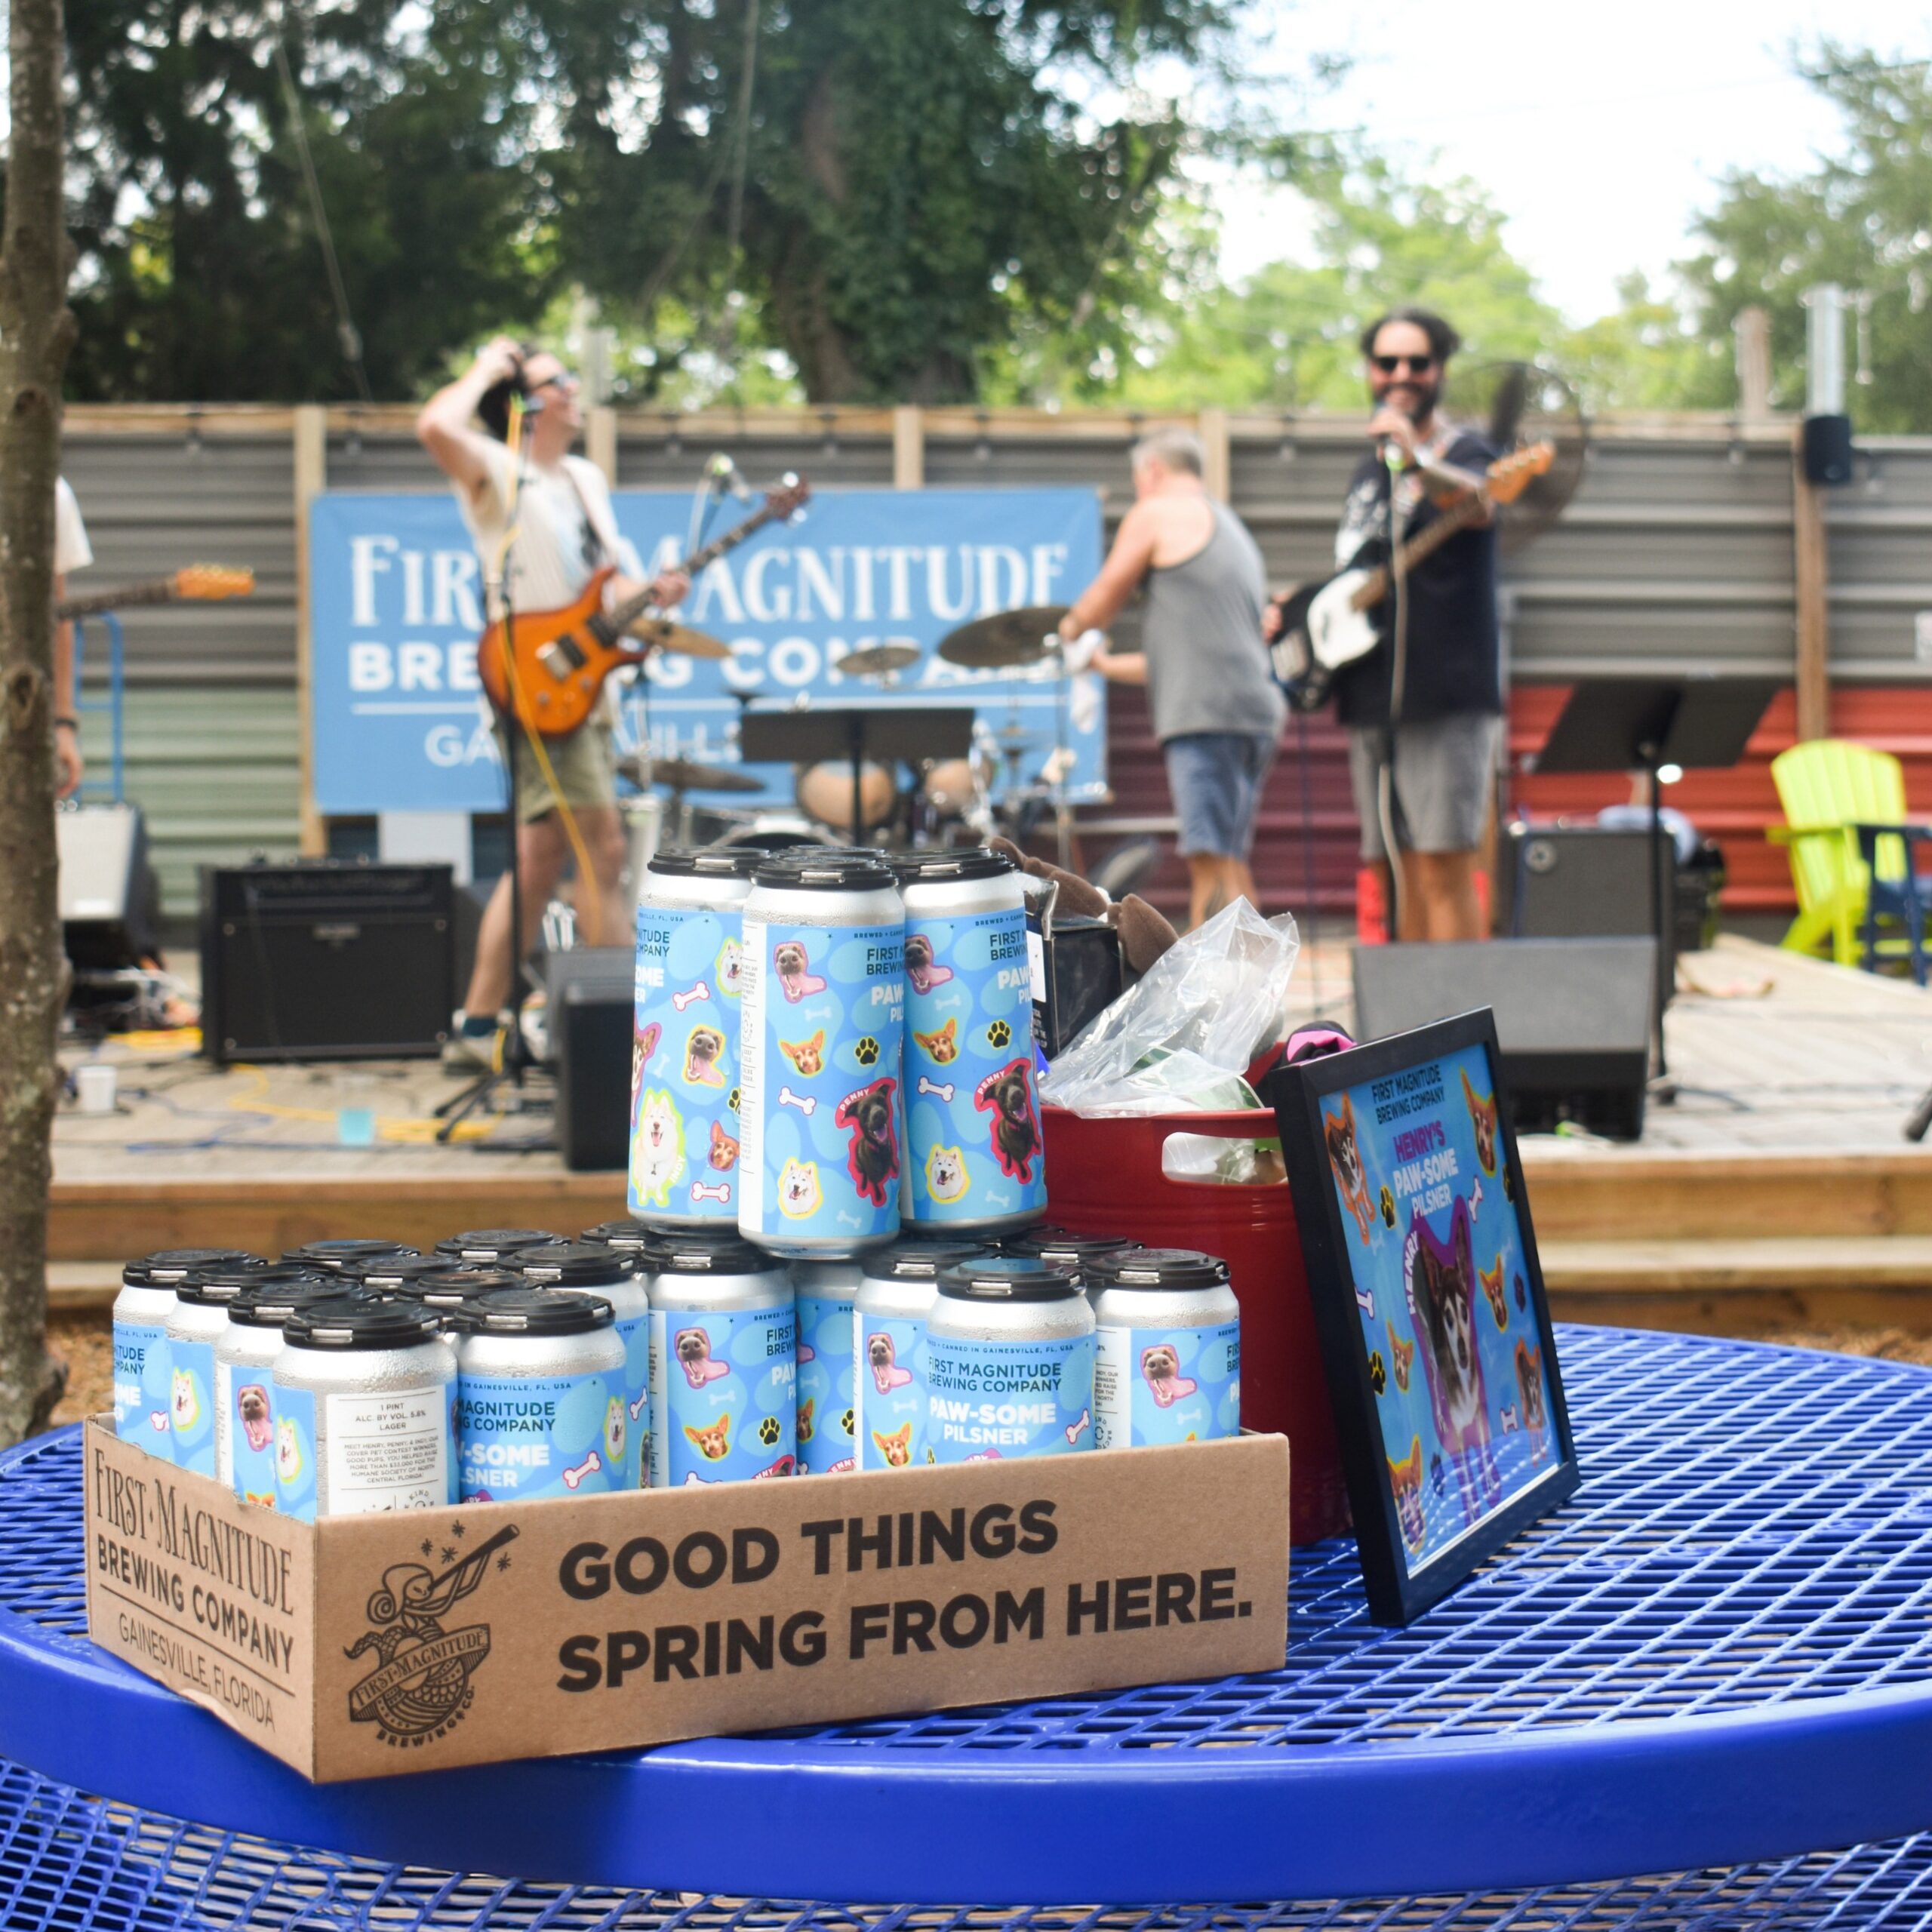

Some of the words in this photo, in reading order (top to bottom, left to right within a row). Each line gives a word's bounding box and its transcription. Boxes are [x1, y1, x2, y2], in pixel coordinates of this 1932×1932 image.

[350, 534, 486, 632] FIR
[989, 930, 1020, 947] FIRST
[867, 946, 899, 961] FIRST
[977, 1070, 1005, 1094] PENNY
[1371, 1079, 1394, 1103] FIRST
[1397, 1064, 1441, 1094] MAGNITUDE
[839, 1088, 869, 1111] PENNY
[1376, 1100, 1411, 1125] BREWING
[1411, 1085, 1445, 1113] COMPANY
[1393, 1121, 1445, 1163] HENRY'S
[1393, 1148, 1459, 1198] PAW-SOME
[1411, 1183, 1452, 1220] PILSNER
[1404, 1230, 1419, 1315] HENRY
[767, 1326, 792, 1342] FIRST
[942, 1343, 968, 1352] CANNED
[929, 1356, 954, 1374] FIRST
[958, 1363, 1061, 1378] MAGNITUDE
[929, 1372, 977, 1391] BREWING
[983, 1377, 1062, 1392] COMPANY
[386, 1402, 405, 1411] PINT
[929, 1396, 1057, 1426] PAW-SOME
[380, 1422, 406, 1431] LAGER
[474, 1418, 555, 1432] COMPANY
[943, 1423, 1028, 1444] PILSNER
[383, 1447, 411, 1455] CONTEST
[387, 1440, 408, 1448] PENNY,
[460, 1441, 550, 1466] -SOME
[401, 1452, 423, 1460] HELPED
[367, 1475, 396, 1484] CENTRAL
[381, 1468, 407, 1476] SOCIETY
[417, 1463, 435, 1472] NORTH
[408, 1489, 429, 1500] KIND
[95, 1447, 146, 1540] FIRST
[155, 1478, 294, 1617] MAGNITUDE
[558, 1528, 780, 1600] GOOD
[801, 1500, 1057, 1577] THINGS
[97, 1533, 185, 1613] BREWING
[192, 1584, 294, 1674] COMPANY
[557, 1610, 826, 1693] SPRING
[849, 1588, 1043, 1660] FROM
[1066, 1567, 1253, 1637] HERE.
[119, 1612, 211, 1694] GAINESVILLE,
[214, 1665, 275, 1733] FLORIDA
[355, 1668, 393, 1706] FIRST
[395, 1631, 485, 1679] MAGNITUDE
[376, 1718, 457, 1748] BREWING
